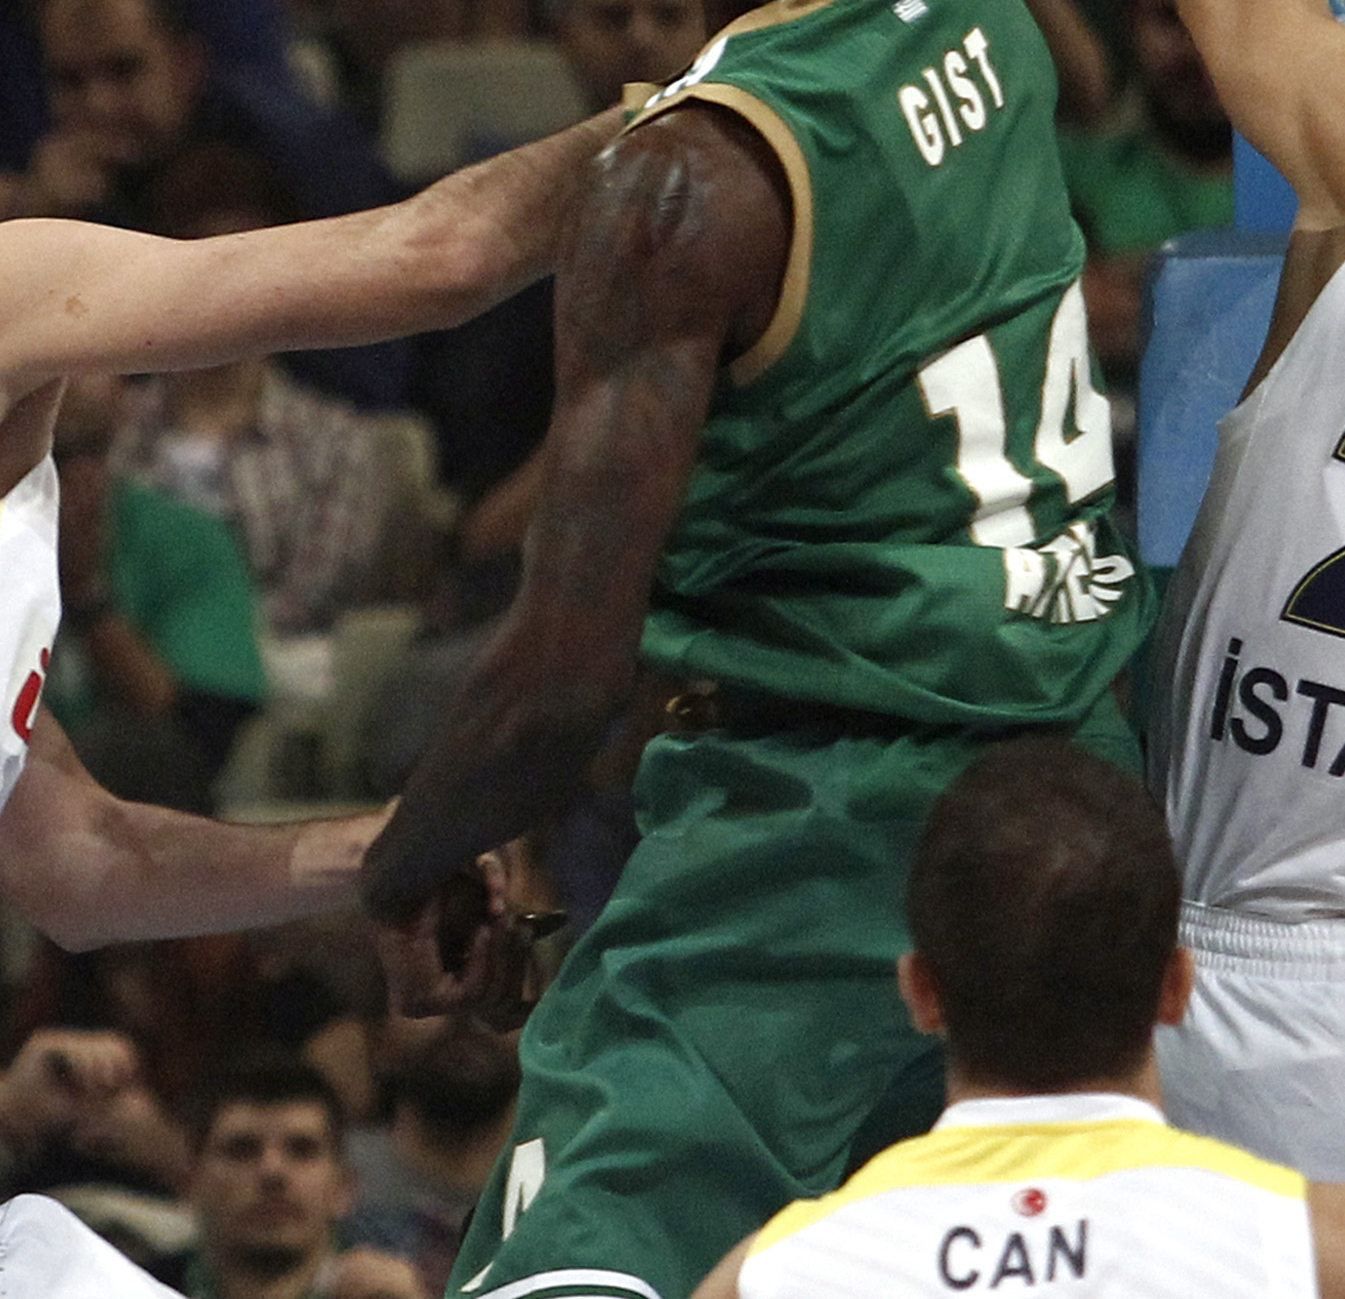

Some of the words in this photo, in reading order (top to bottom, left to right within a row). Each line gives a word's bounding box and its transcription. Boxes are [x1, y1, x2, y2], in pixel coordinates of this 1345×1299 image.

[897, 26, 1005, 168] GIST
[915, 276, 1117, 549] 14
[936, 1217, 1090, 1291] CAN
